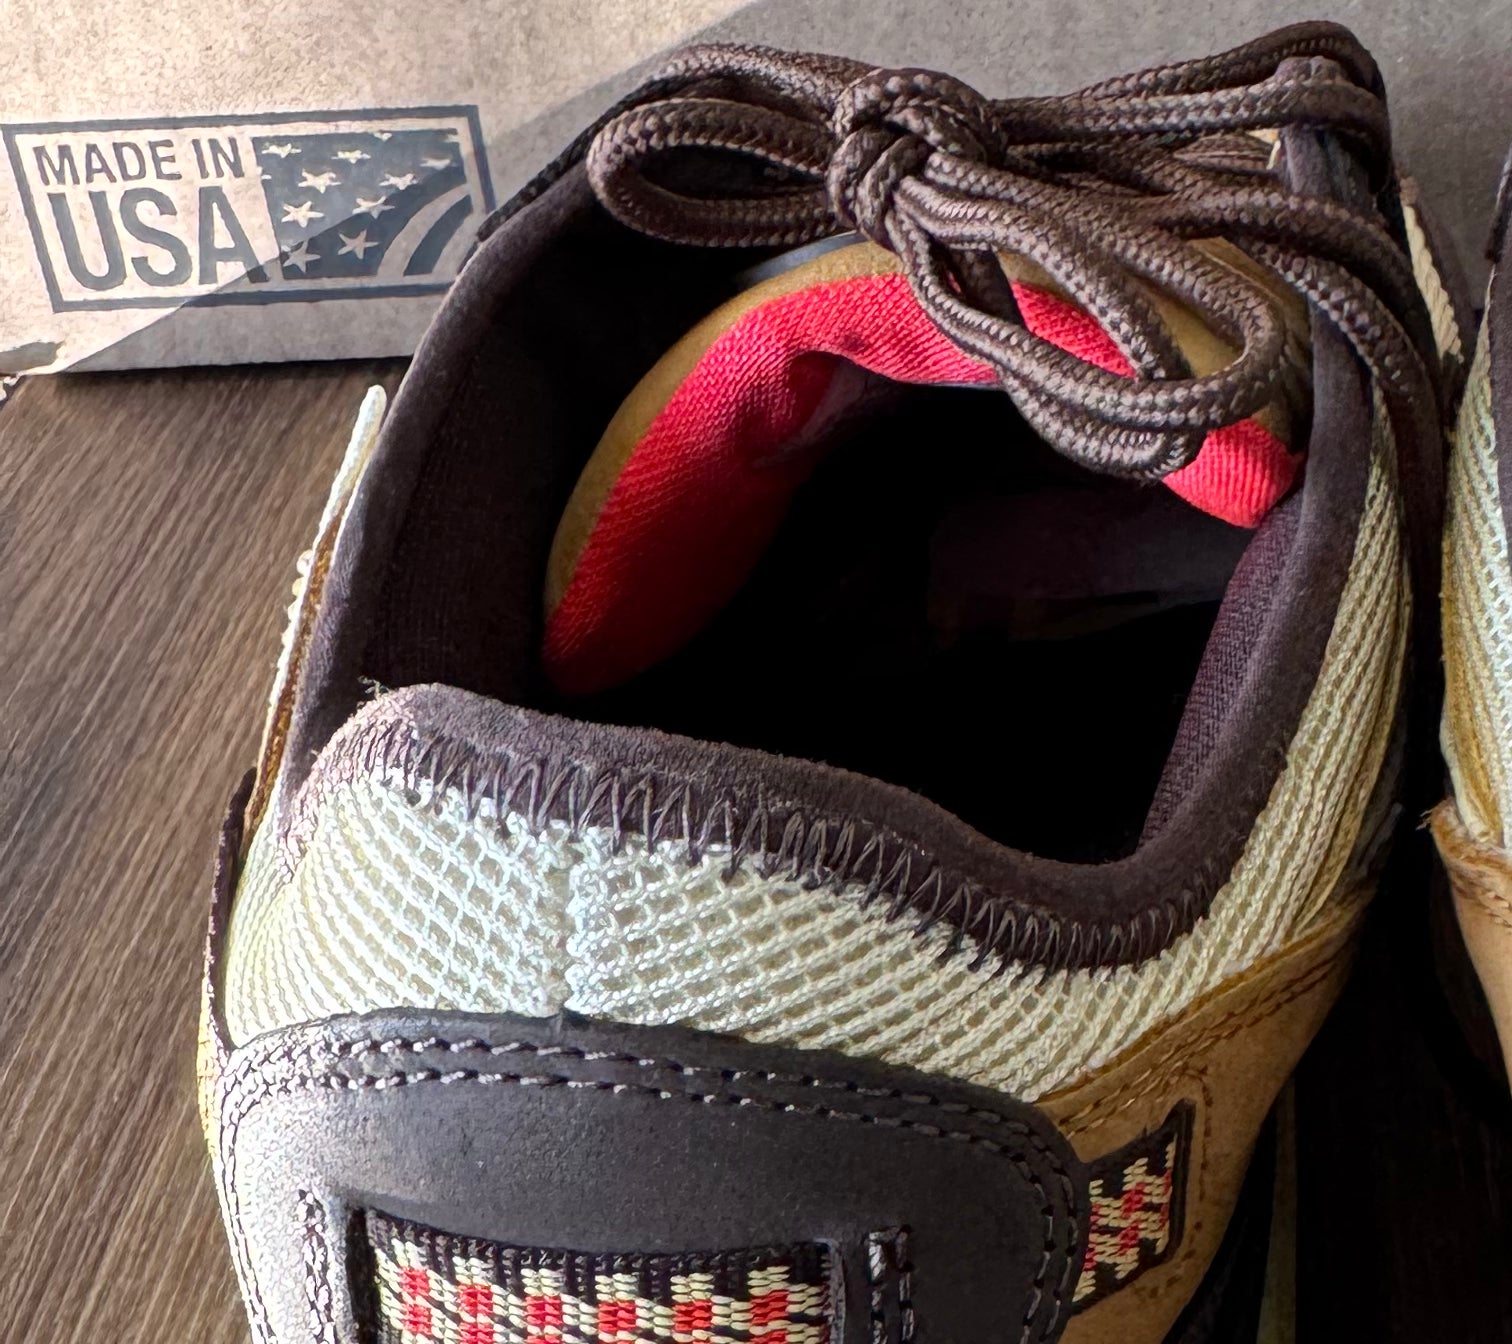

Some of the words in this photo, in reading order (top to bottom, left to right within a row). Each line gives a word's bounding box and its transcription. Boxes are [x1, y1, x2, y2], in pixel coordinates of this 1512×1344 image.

[32, 138, 182, 186] MADE
[191, 136, 246, 179] IN
[47, 185, 271, 291] USA
